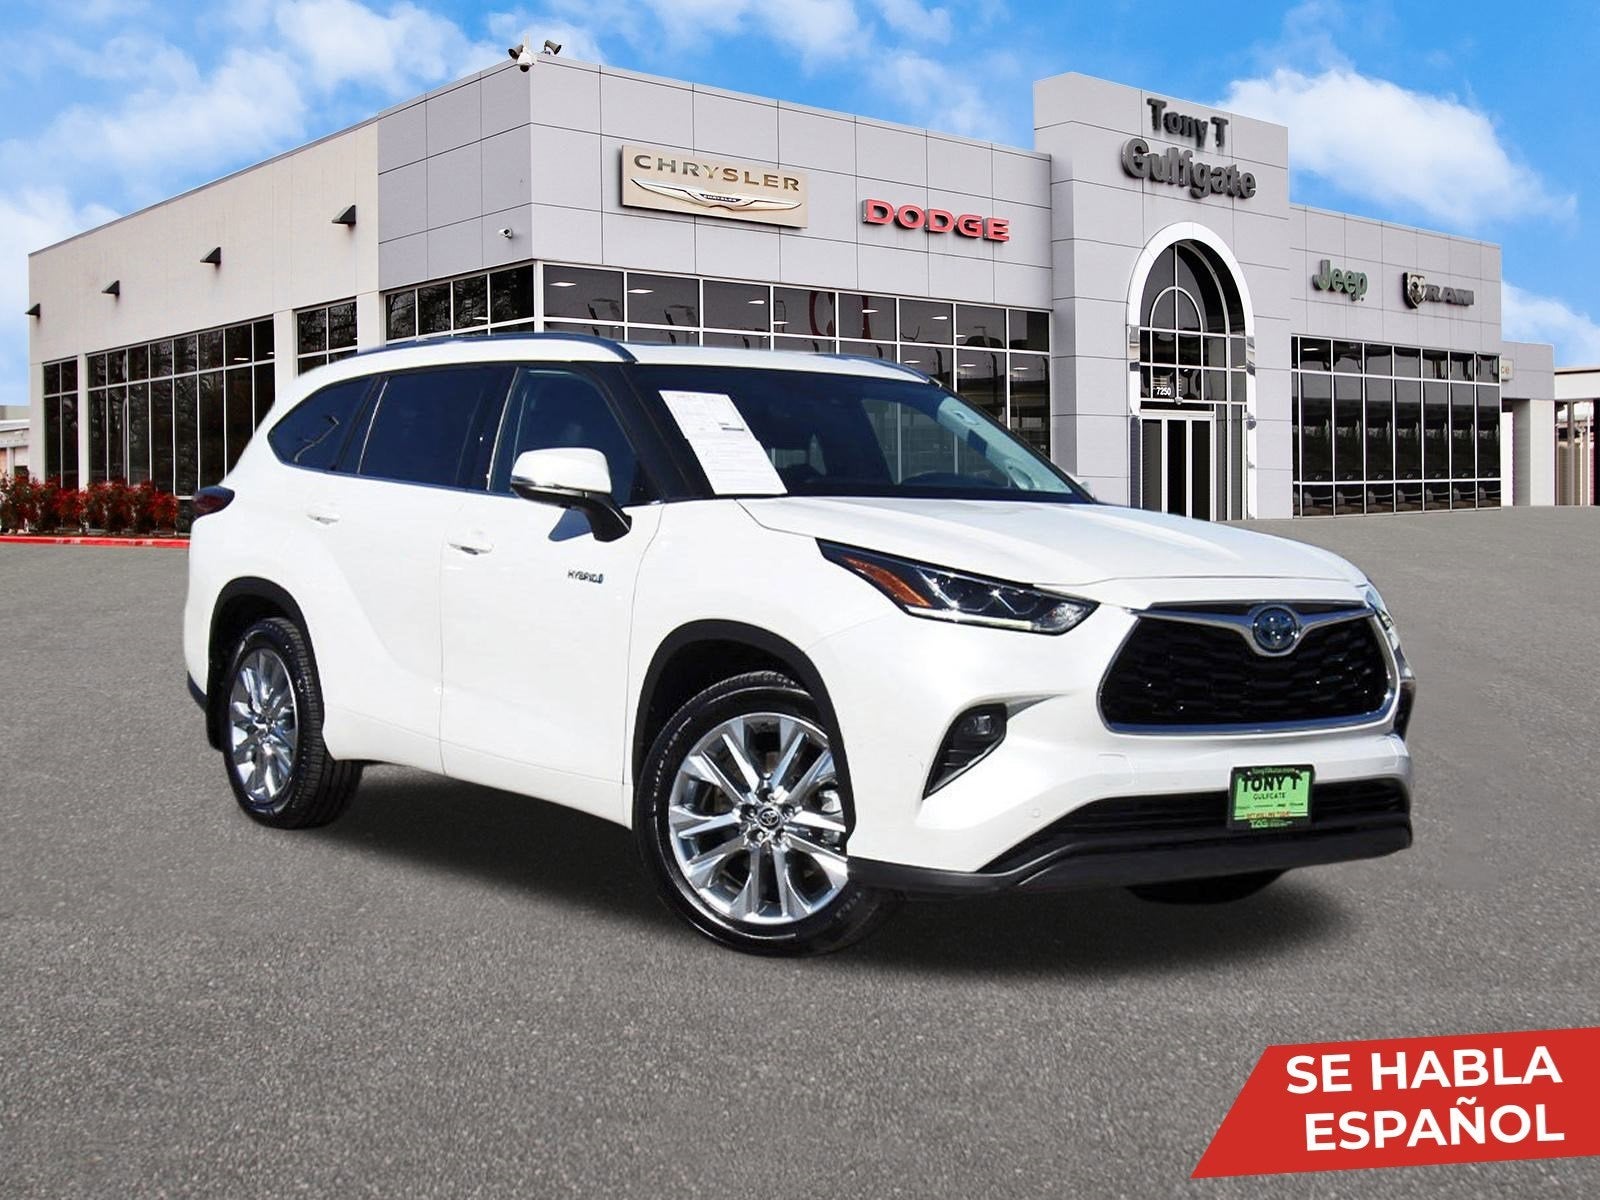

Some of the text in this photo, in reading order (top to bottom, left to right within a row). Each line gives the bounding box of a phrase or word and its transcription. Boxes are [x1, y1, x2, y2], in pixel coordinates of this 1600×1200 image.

[1147, 97, 1229, 147] Tony T
[633, 154, 800, 192] CHRYSLER
[1121, 138, 1256, 199] Gulfgate
[862, 198, 1010, 243] DODGE
[1312, 259, 1368, 302] Jeep
[1425, 284, 1474, 306] RAM
[1242, 773, 1285, 792] TONY
[1289, 772, 1303, 790] T
